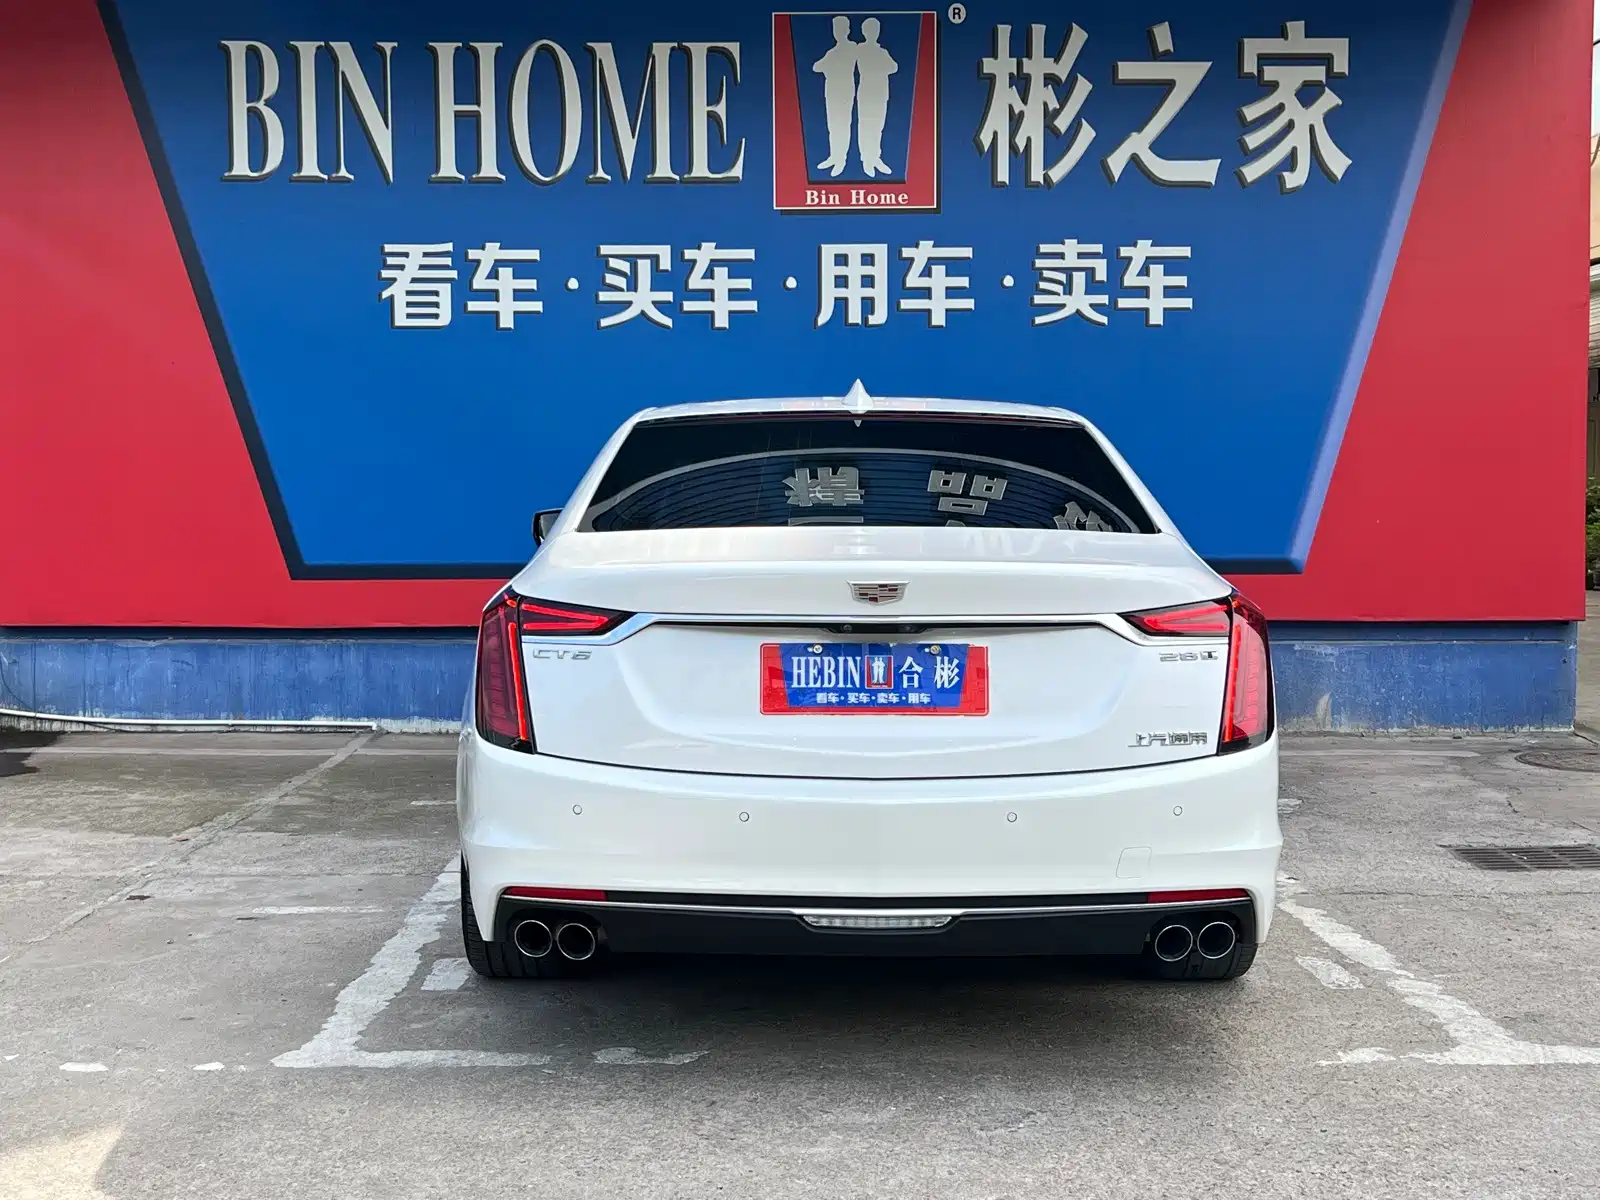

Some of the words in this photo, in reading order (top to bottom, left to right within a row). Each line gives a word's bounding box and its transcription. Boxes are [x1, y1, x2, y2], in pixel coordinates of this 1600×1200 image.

[219, 40, 398, 186] BIN
[426, 39, 746, 187] HOME
[974, 20, 1353, 193] 彬之家
[805, 189, 840, 205] Bin
[850, 189, 909, 205] Home
[532, 648, 593, 661] CT6
[1158, 650, 1219, 663] 28T
[791, 655, 861, 689] HEBIN
